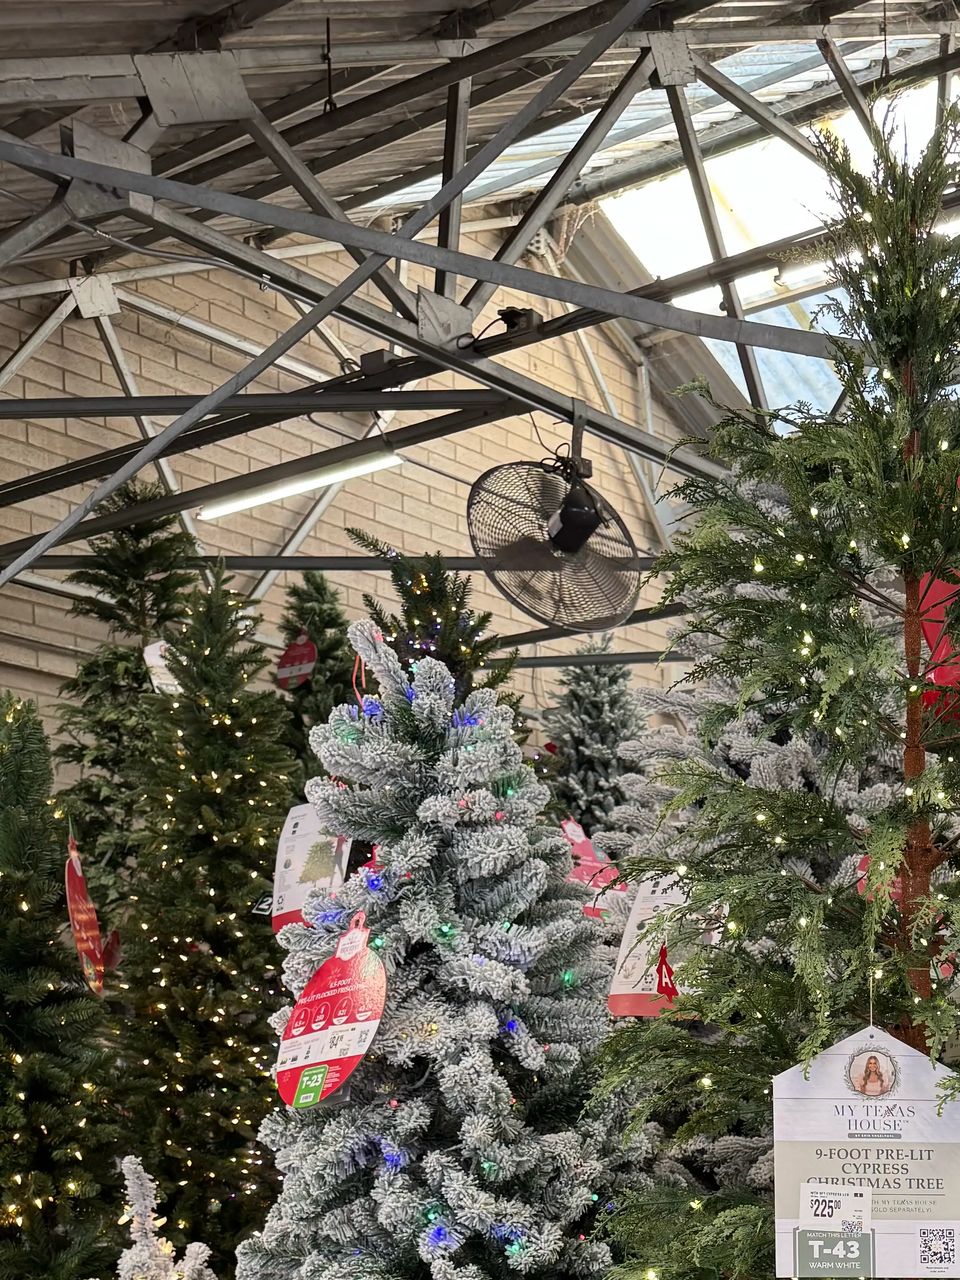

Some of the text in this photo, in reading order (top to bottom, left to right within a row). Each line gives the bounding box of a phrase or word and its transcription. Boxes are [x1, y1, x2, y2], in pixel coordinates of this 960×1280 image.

[662, 964, 672, 988] A
[302, 1074, 323, 1089] T-23
[834, 1104, 916, 1118] MY TEXAS
[816, 1148, 934, 1160] 9-FOOT PRE-LIT
[842, 1163, 909, 1175] CYPRESS
[807, 1177, 944, 1190] CHRISTMAS TREE
[808, 1241, 860, 1258] T-43
